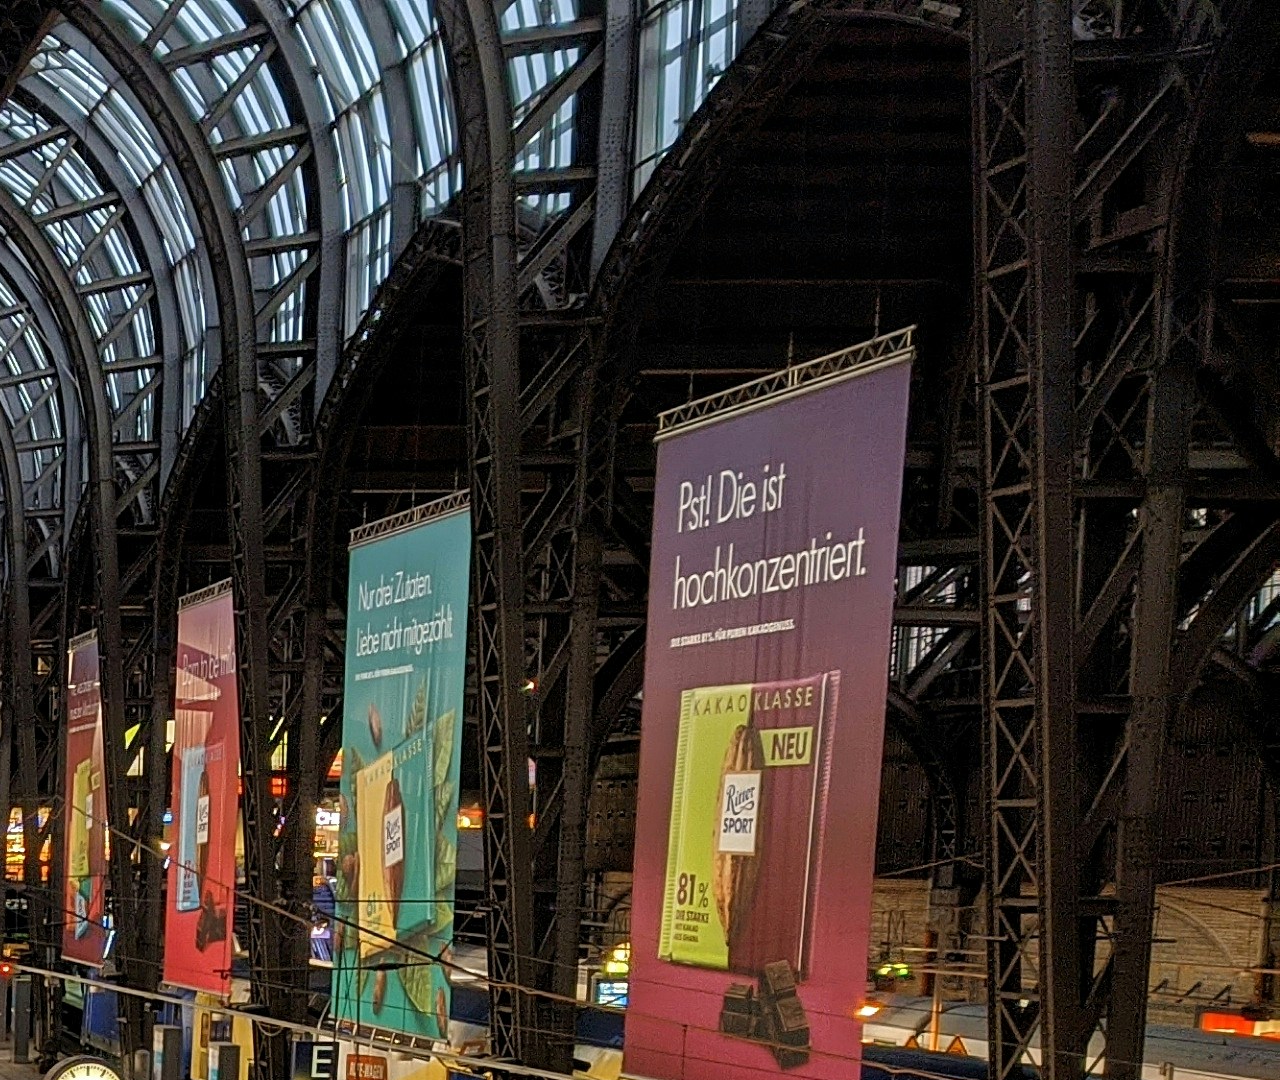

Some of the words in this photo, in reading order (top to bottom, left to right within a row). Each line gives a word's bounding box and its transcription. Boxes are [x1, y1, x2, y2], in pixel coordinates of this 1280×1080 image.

[678, 475, 712, 532] Pst!
[717, 469, 756, 524] Die
[762, 463, 786, 512] ist
[673, 527, 866, 609] hochkonzentriert.
[359, 580, 374, 612] Nur
[376, 573, 393, 608] drei
[394, 571, 432, 604] Zutaten.
[381, 616, 403, 652] nicht
[693, 694, 748, 716] KAKAO
[754, 686, 814, 712] KLASSE
[771, 731, 809, 761] NEU
[726, 784, 756, 816] Ritter
[722, 817, 754, 834] SPORT
[677, 872, 697, 906] 81
[698, 882, 710, 908] %
[310, 1045, 334, 1079] E
